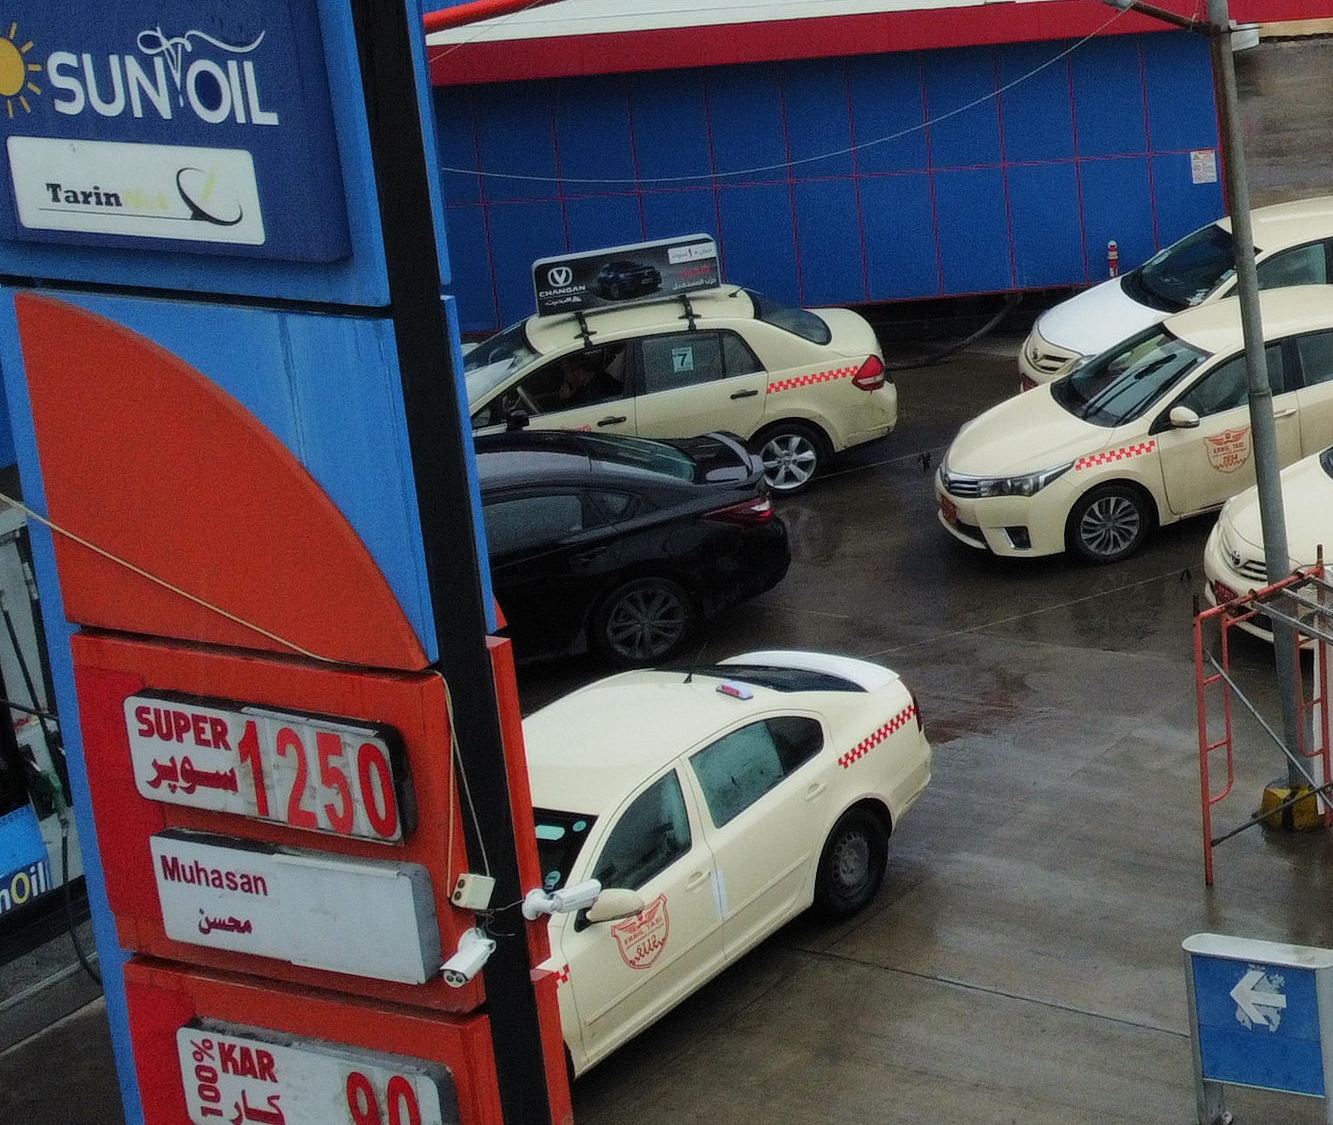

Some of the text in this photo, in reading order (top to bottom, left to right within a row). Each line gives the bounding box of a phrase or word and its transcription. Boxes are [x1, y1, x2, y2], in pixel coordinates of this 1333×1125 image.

[538, 285, 587, 298] CHANGAN
[135, 705, 397, 838] SUPER 1250
[147, 755, 238, 794] سوپر
[160, 854, 269, 897] Muhasan
[198, 908, 253, 935] محسن
[190, 1038, 224, 1118] 100%
[218, 1041, 279, 1084] KAR
